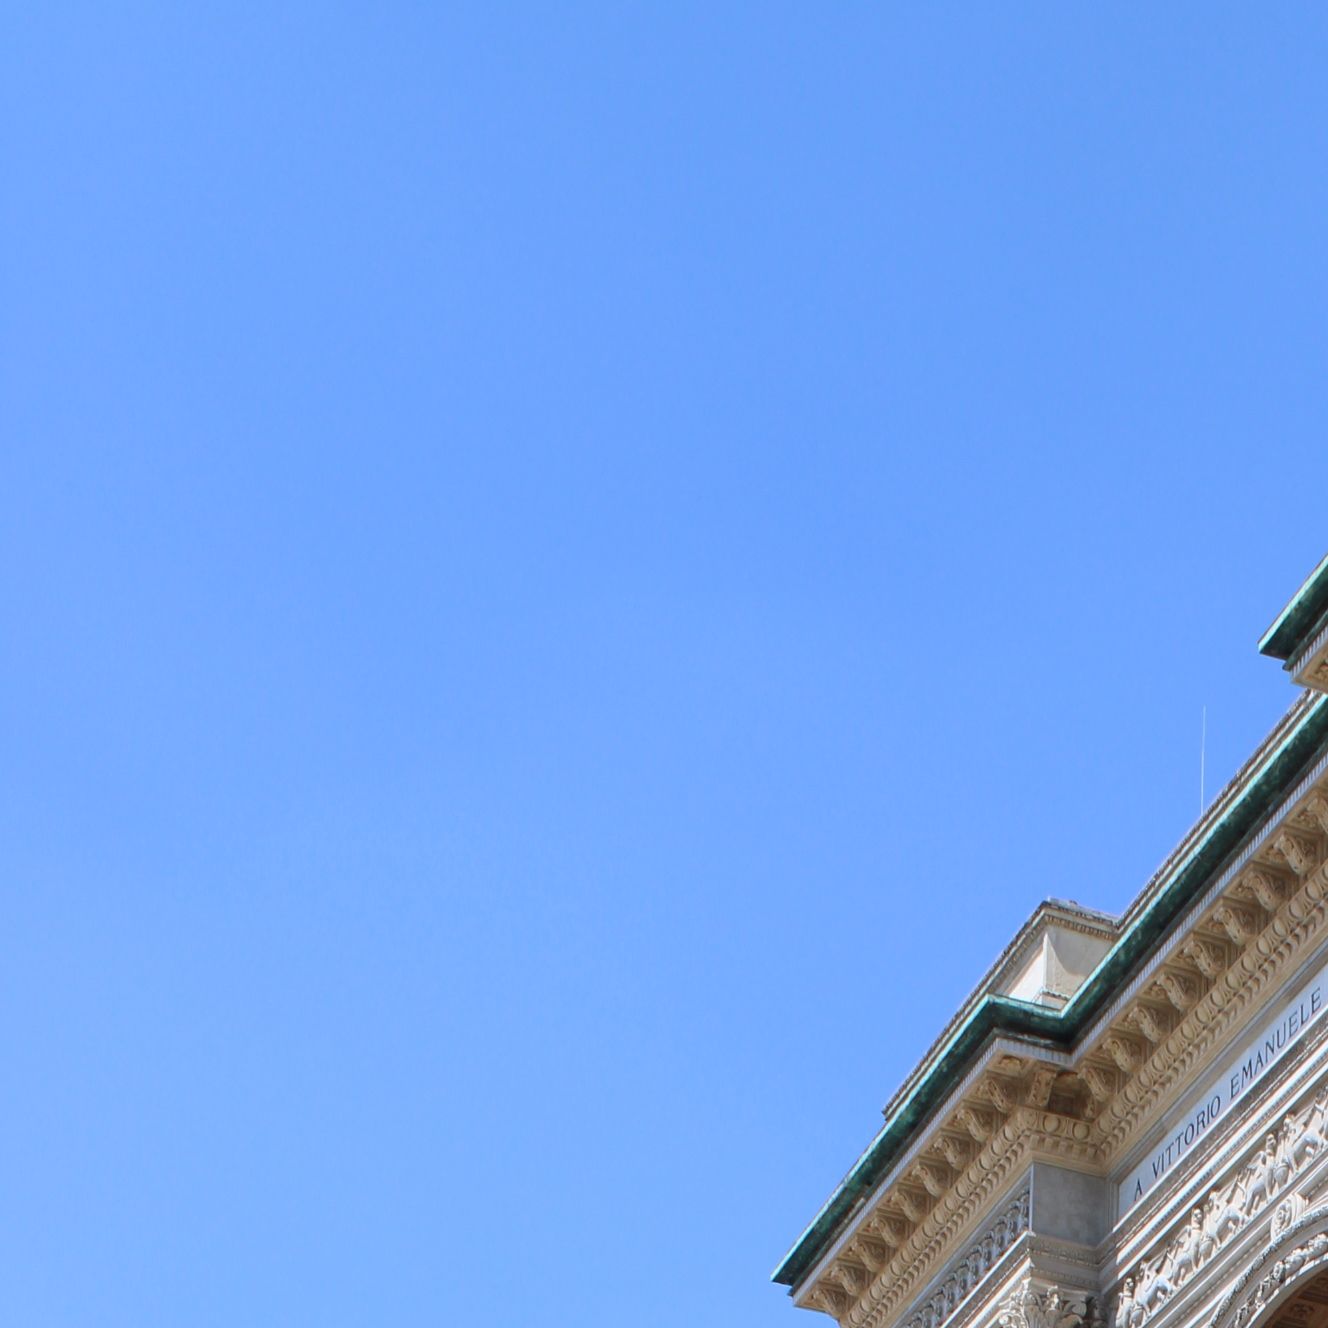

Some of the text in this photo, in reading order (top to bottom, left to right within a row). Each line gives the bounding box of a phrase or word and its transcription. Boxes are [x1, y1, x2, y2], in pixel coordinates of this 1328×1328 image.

[1134, 1178, 1144, 1202] A
[1151, 1094, 1222, 1179] VITTORIO
[1229, 986, 1323, 1099] EMANUELE
